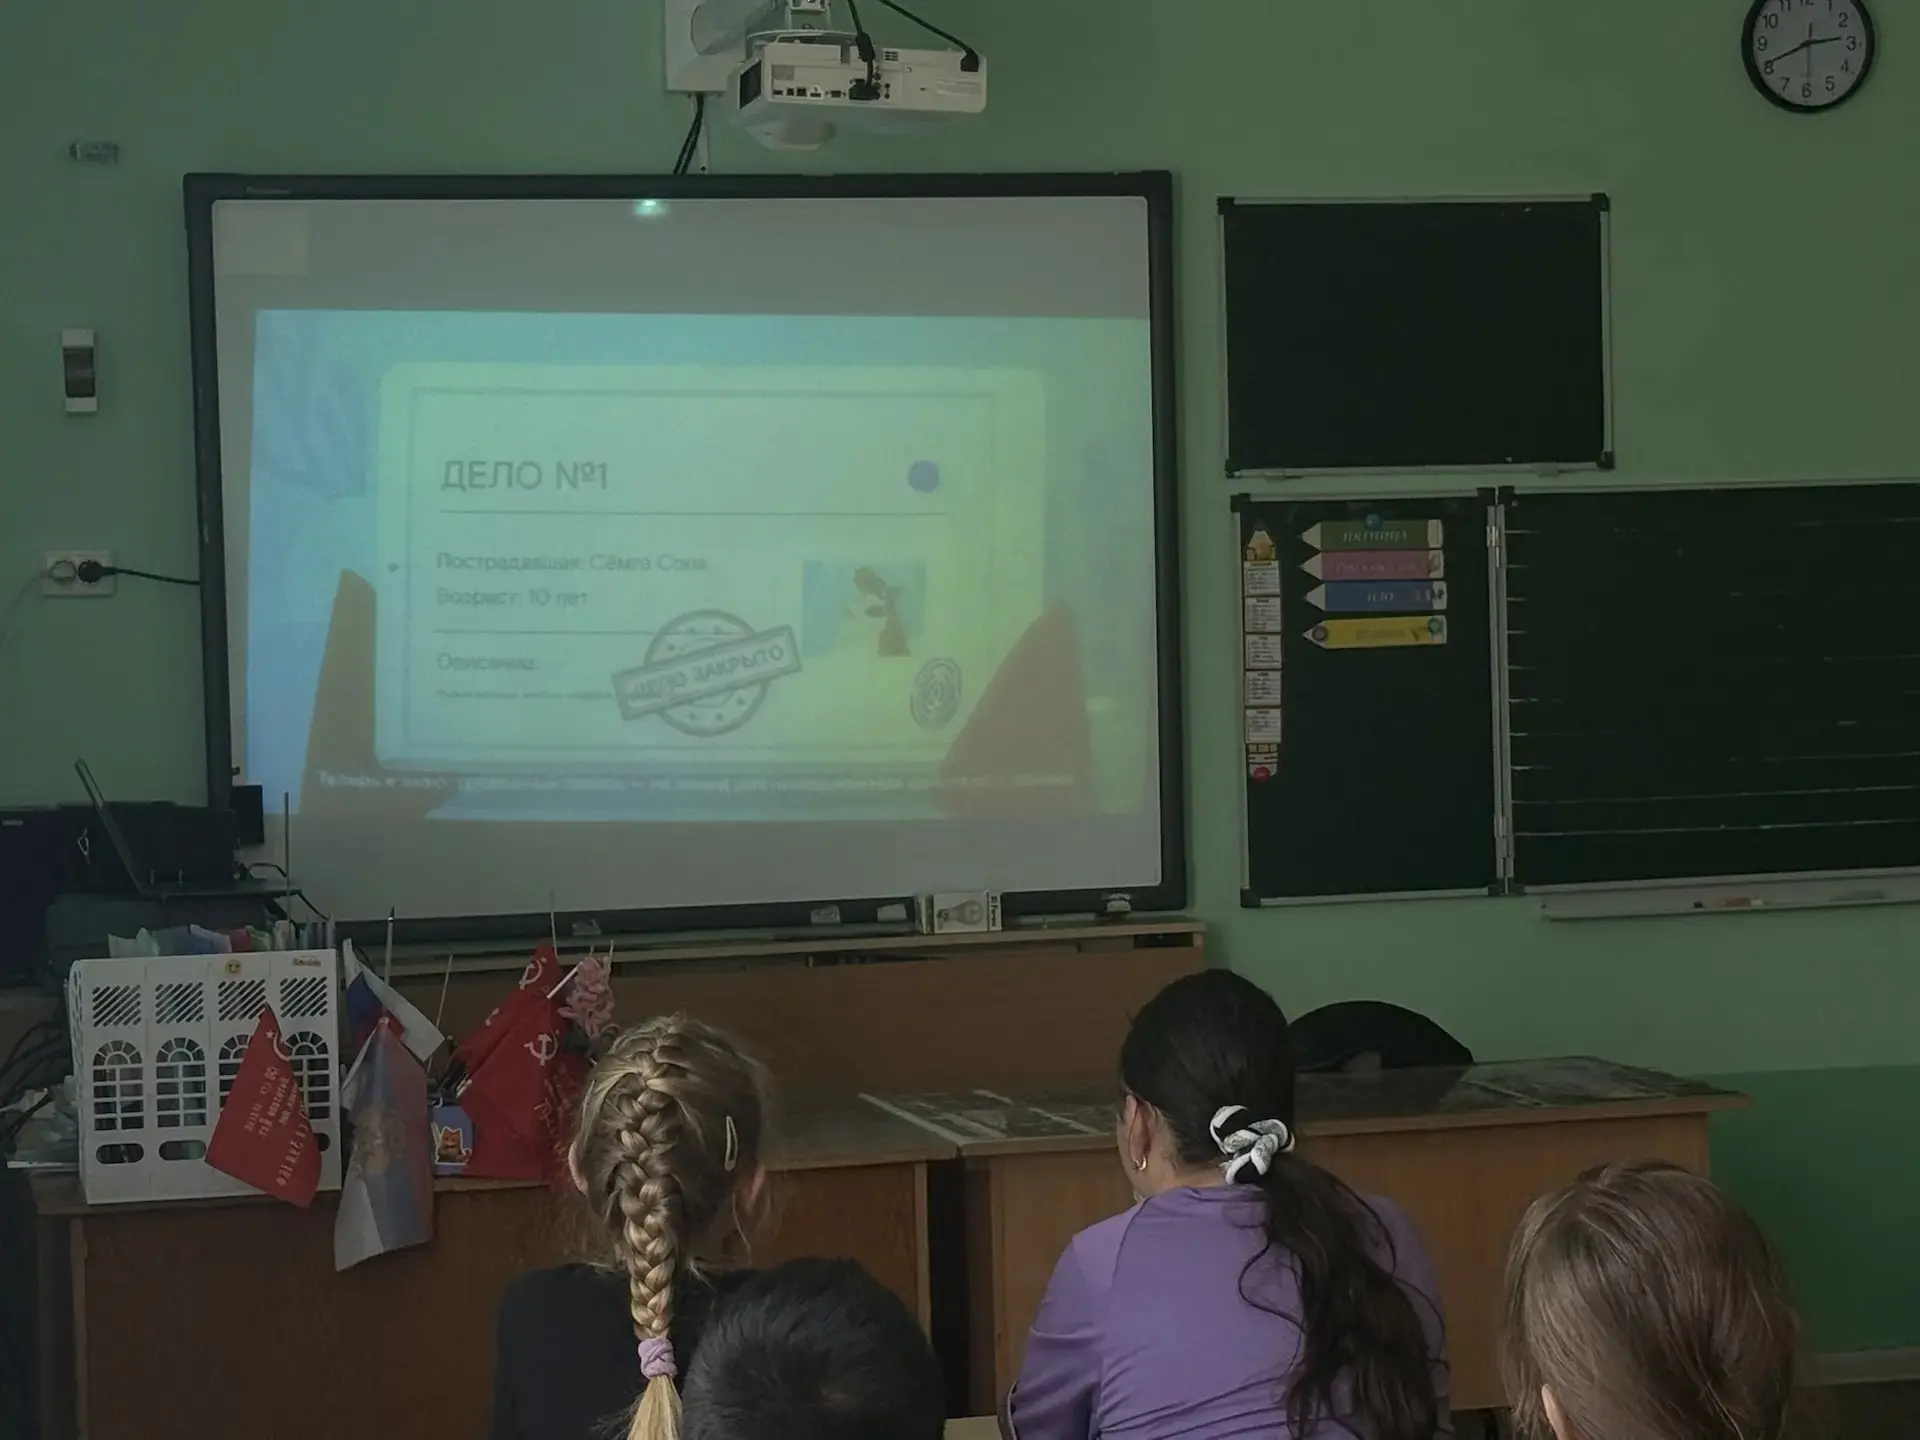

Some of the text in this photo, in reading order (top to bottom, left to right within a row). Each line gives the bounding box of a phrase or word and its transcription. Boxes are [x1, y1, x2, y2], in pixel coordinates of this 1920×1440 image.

[1762, 13, 1778, 29] 10
[1838, 12, 1849, 28] 2
[1757, 36, 1768, 51] 9
[1846, 35, 1857, 51] 3
[1764, 59, 1775, 75] 8
[1840, 59, 1849, 73] 4
[1780, 77, 1790, 92] 7
[1802, 82, 1812, 98] 6
[1825, 76, 1835, 92] 5
[441, 460, 608, 492] ДЕЛО №1
[529, 588, 550, 606] 10
[557, 591, 588, 607] лет
[693, 644, 785, 681] ЗАКРЫТО
